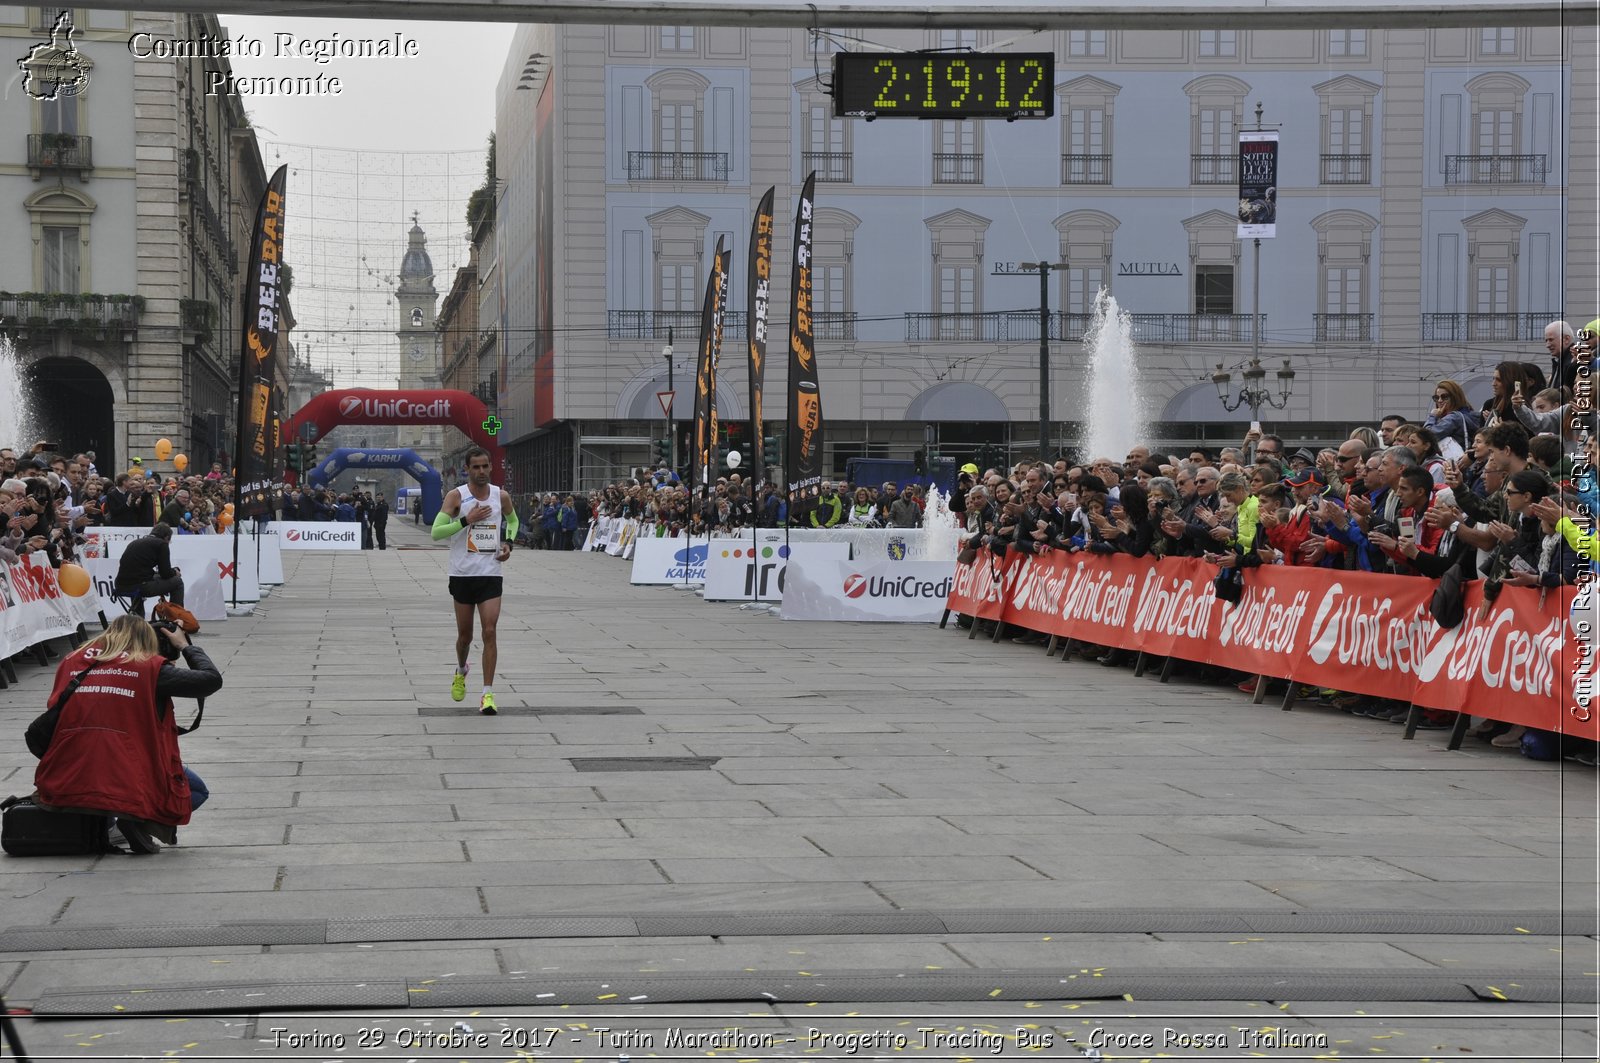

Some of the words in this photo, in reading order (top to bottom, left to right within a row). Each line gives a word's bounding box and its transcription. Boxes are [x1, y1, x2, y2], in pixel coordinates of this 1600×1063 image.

[874, 60, 1042, 107] 2:19:12
[1243, 152, 1274, 161] SOTTO
[1119, 262, 1180, 273] MUTUA
[365, 398, 451, 418] UniCredit
[367, 454, 402, 463] KARHU
[301, 529, 356, 543] UniCredit
[869, 575, 953, 599] UniCredi
[1234, 585, 1311, 655] UniCredit
[1447, 607, 1568, 698] UniCredit
[100, 685, 135, 698] UFFICIALE
